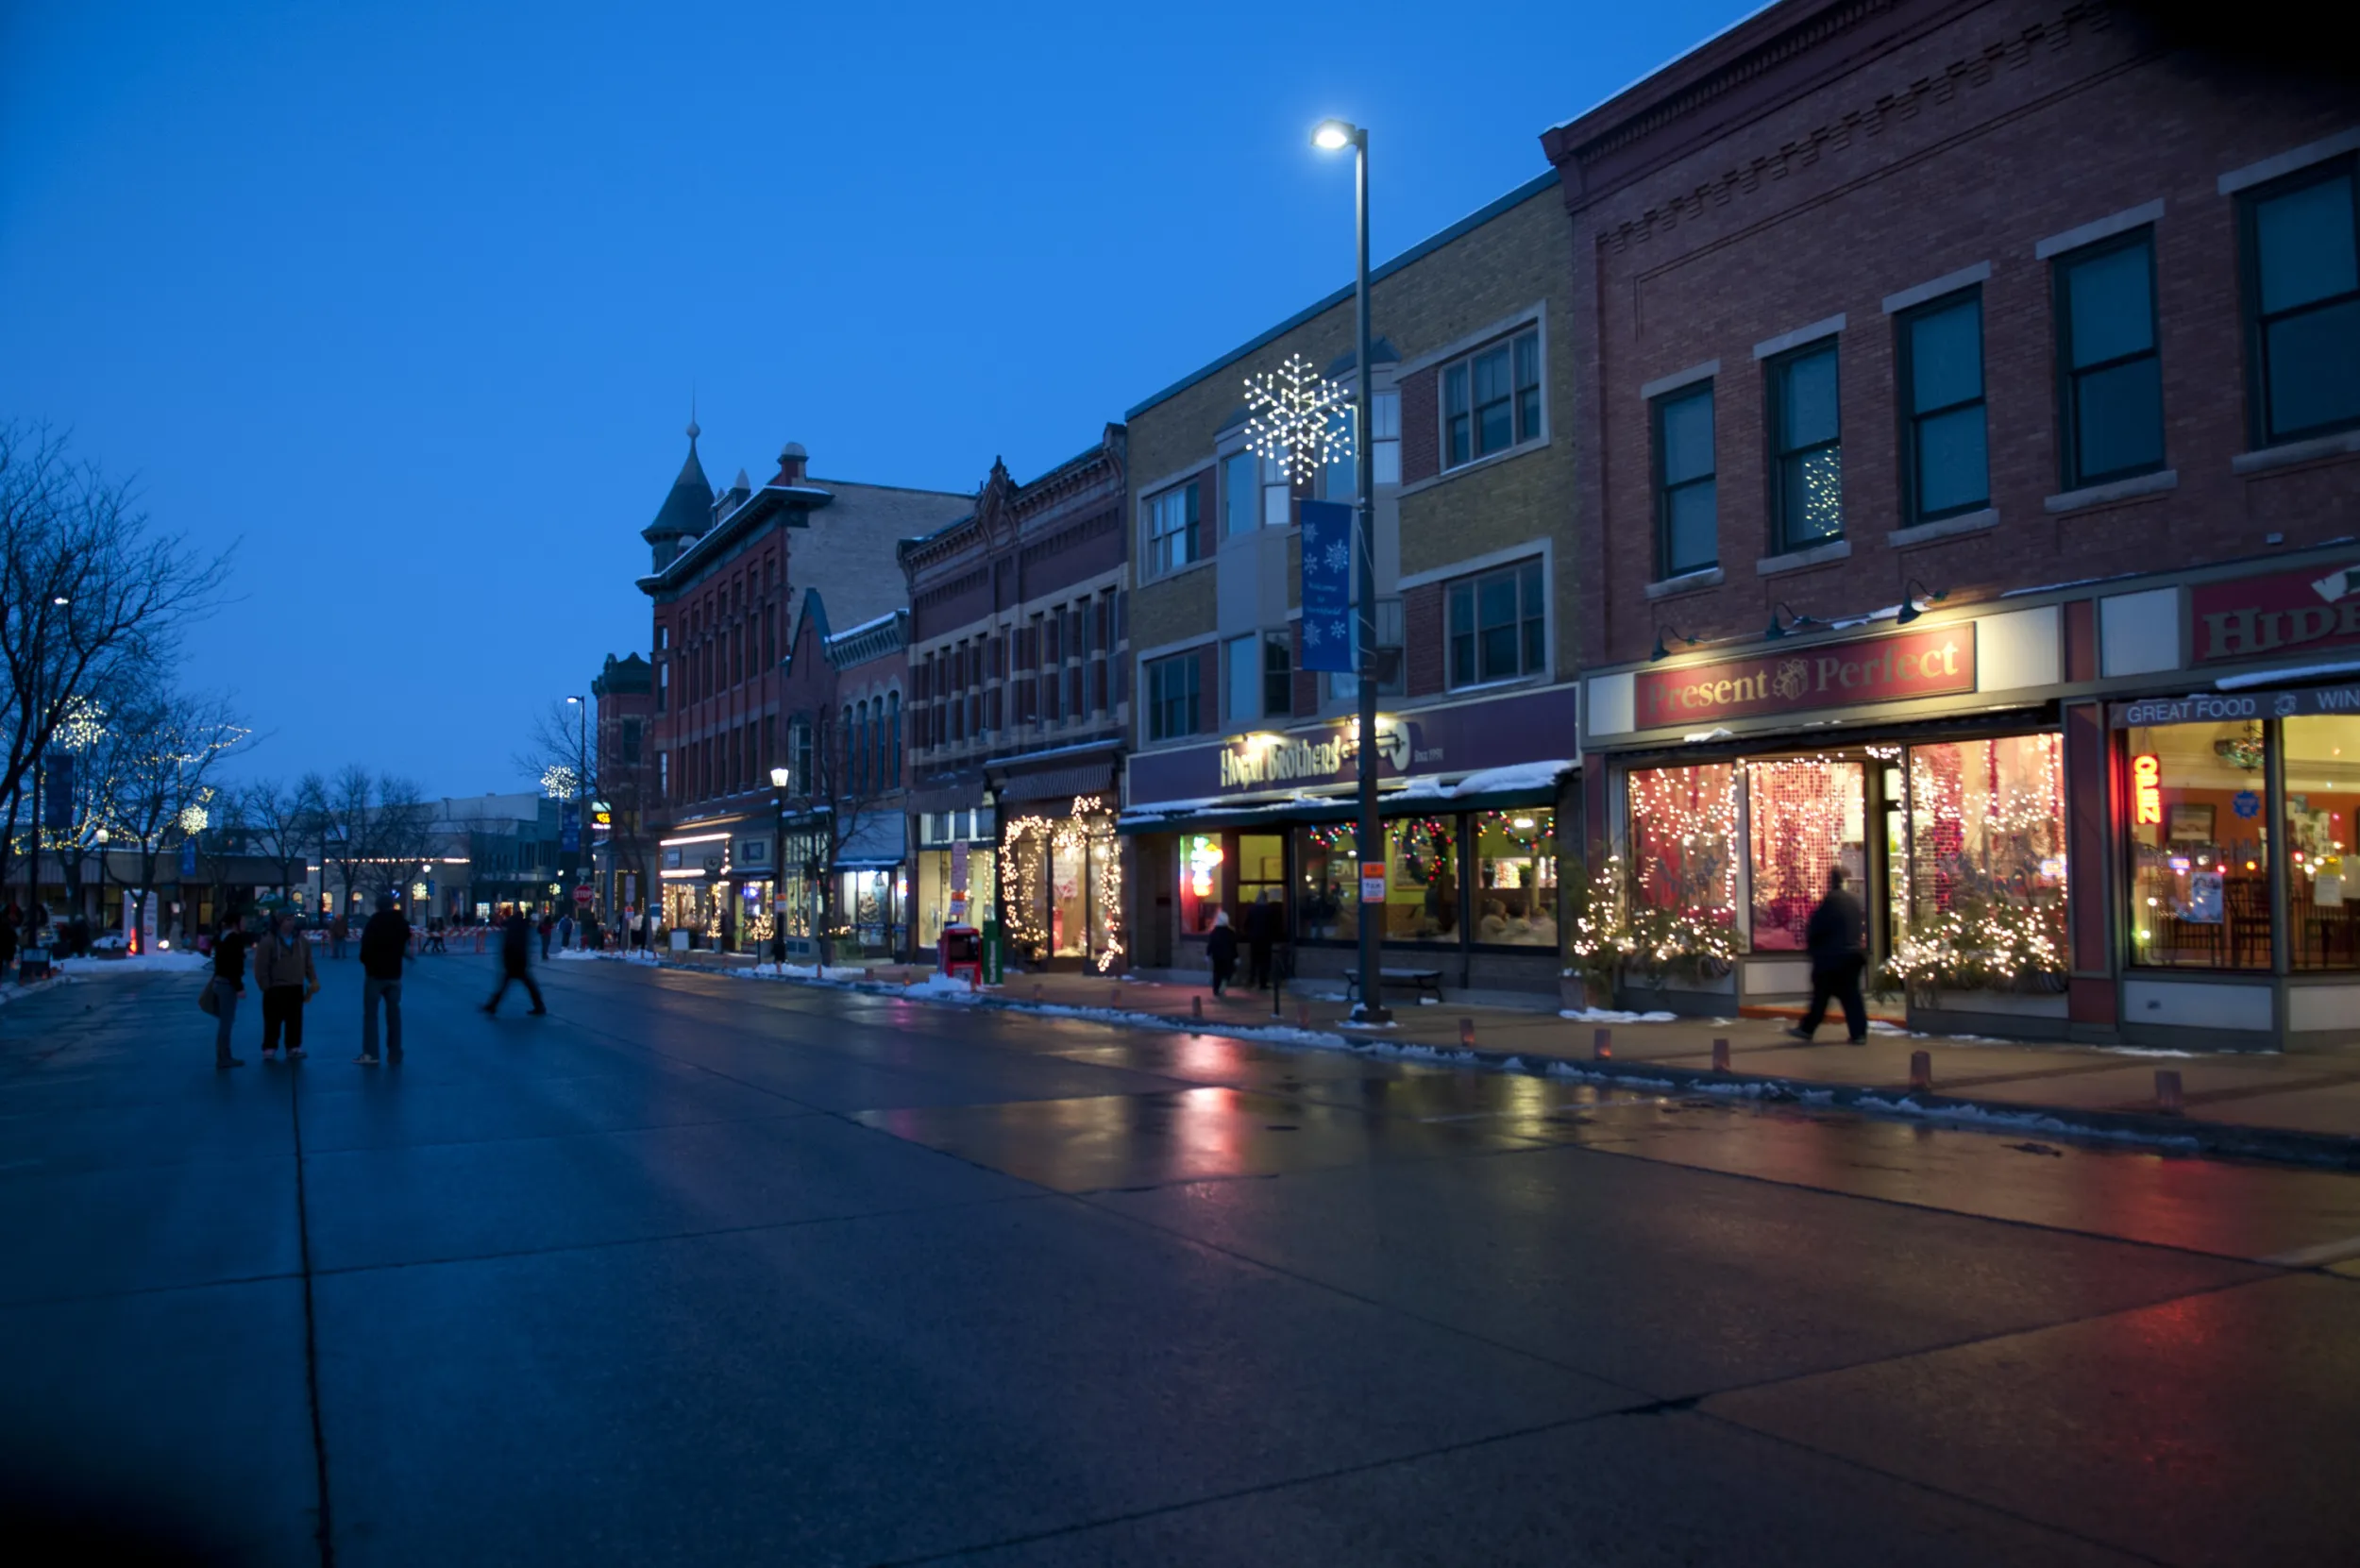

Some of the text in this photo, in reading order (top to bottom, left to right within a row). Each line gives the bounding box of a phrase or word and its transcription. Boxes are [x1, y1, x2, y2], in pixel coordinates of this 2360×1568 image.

[1648, 641, 1960, 714] Present Perfect
[2127, 701, 2191, 723] GREAT
[2196, 698, 2255, 717] FOOD
[2133, 755, 2162, 824] OPEN
